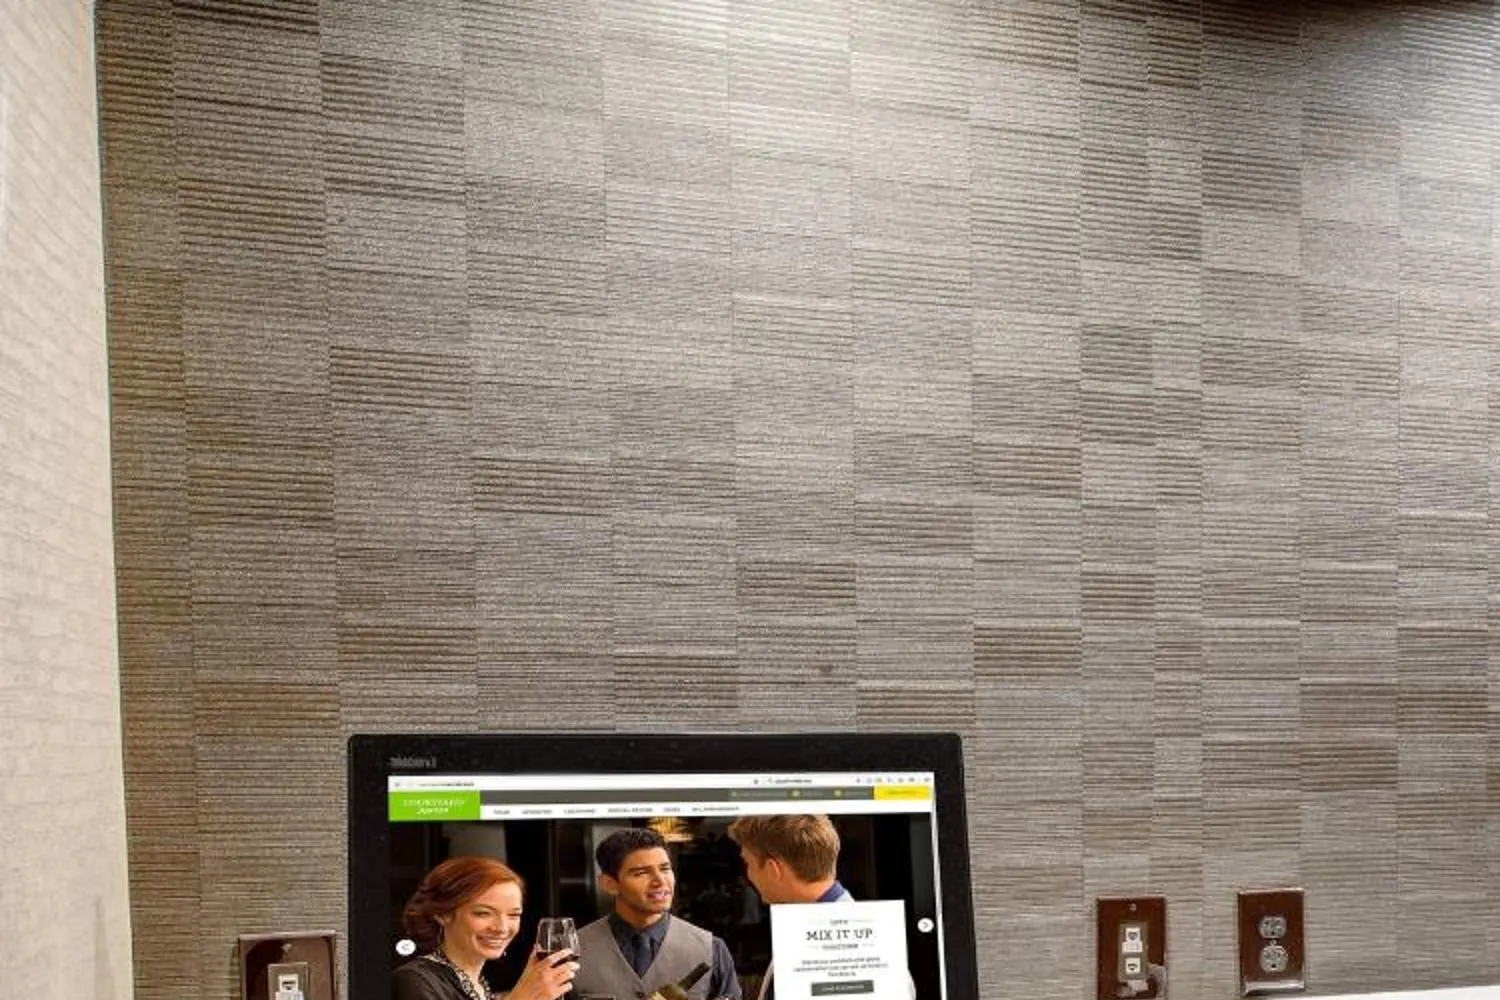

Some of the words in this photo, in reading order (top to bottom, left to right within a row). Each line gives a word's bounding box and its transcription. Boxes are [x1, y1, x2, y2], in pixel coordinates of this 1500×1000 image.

[805, 929, 833, 941] MIX
[836, 929, 851, 940] IT
[853, 927, 873, 940] UP
